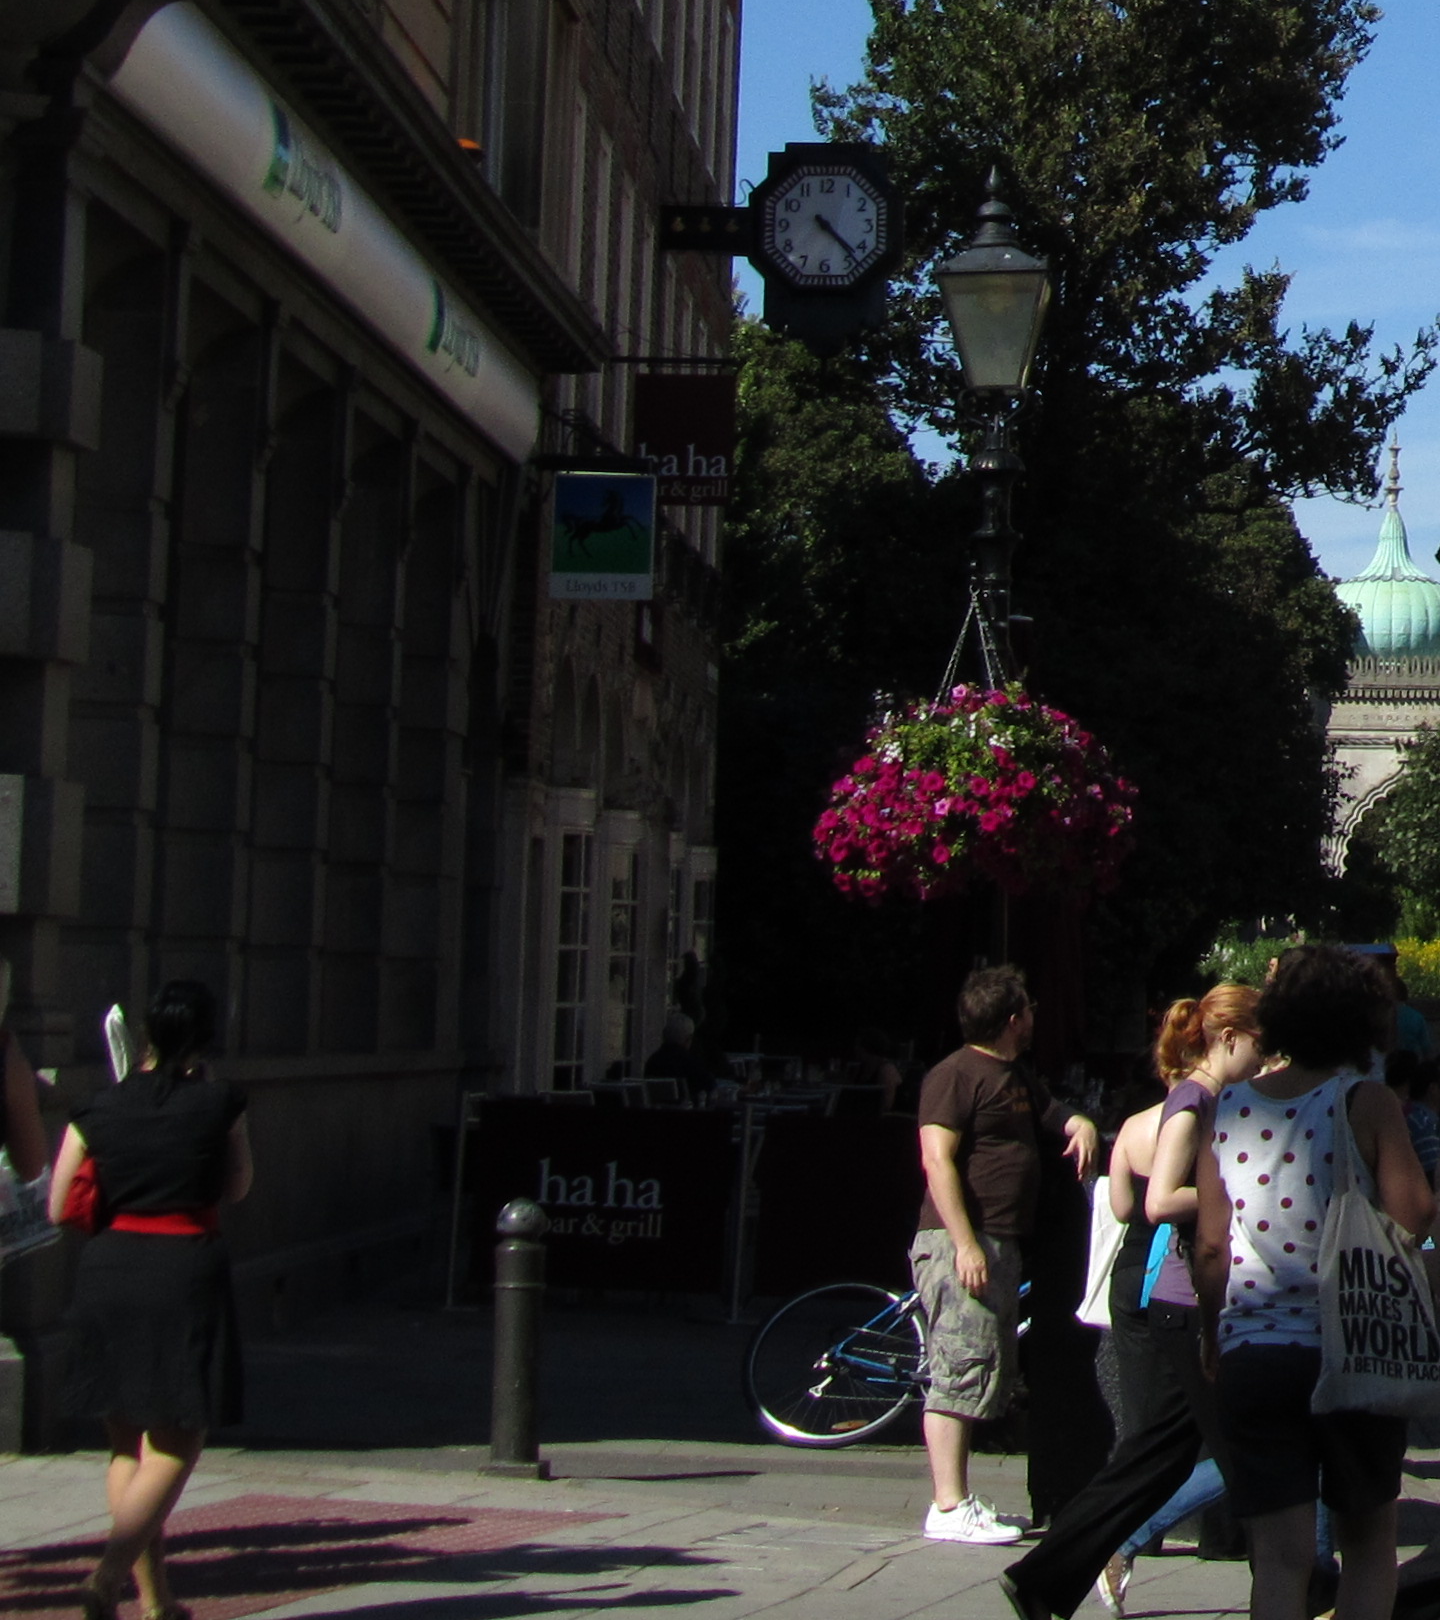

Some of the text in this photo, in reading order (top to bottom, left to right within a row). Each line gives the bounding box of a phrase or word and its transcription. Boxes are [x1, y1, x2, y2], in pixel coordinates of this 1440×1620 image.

[801, 183, 810, 196] 11
[820, 179, 835, 194] 12
[846, 184, 850, 198] 1
[784, 199, 801, 212] 10
[857, 198, 867, 212] 2
[778, 219, 790, 233] 9
[864, 219, 874, 233] 3
[782, 239, 794, 253] 8
[857, 240, 867, 253] 4
[800, 256, 808, 269] 7
[819, 259, 831, 273] 6
[843, 256, 851, 270] 5
[686, 443, 728, 477] ha
[670, 481, 686, 497] &
[691, 480, 728, 502] grill
[536, 1156, 664, 1209] ha ha
[550, 1212, 663, 1245] ar & grill
[1339, 1247, 1412, 1298] MUS
[1339, 1291, 1402, 1322] MAKES
[1341, 1316, 1440, 1362] WORLD
[1342, 1357, 1350, 1374] A
[1354, 1356, 1403, 1379] BETTER
